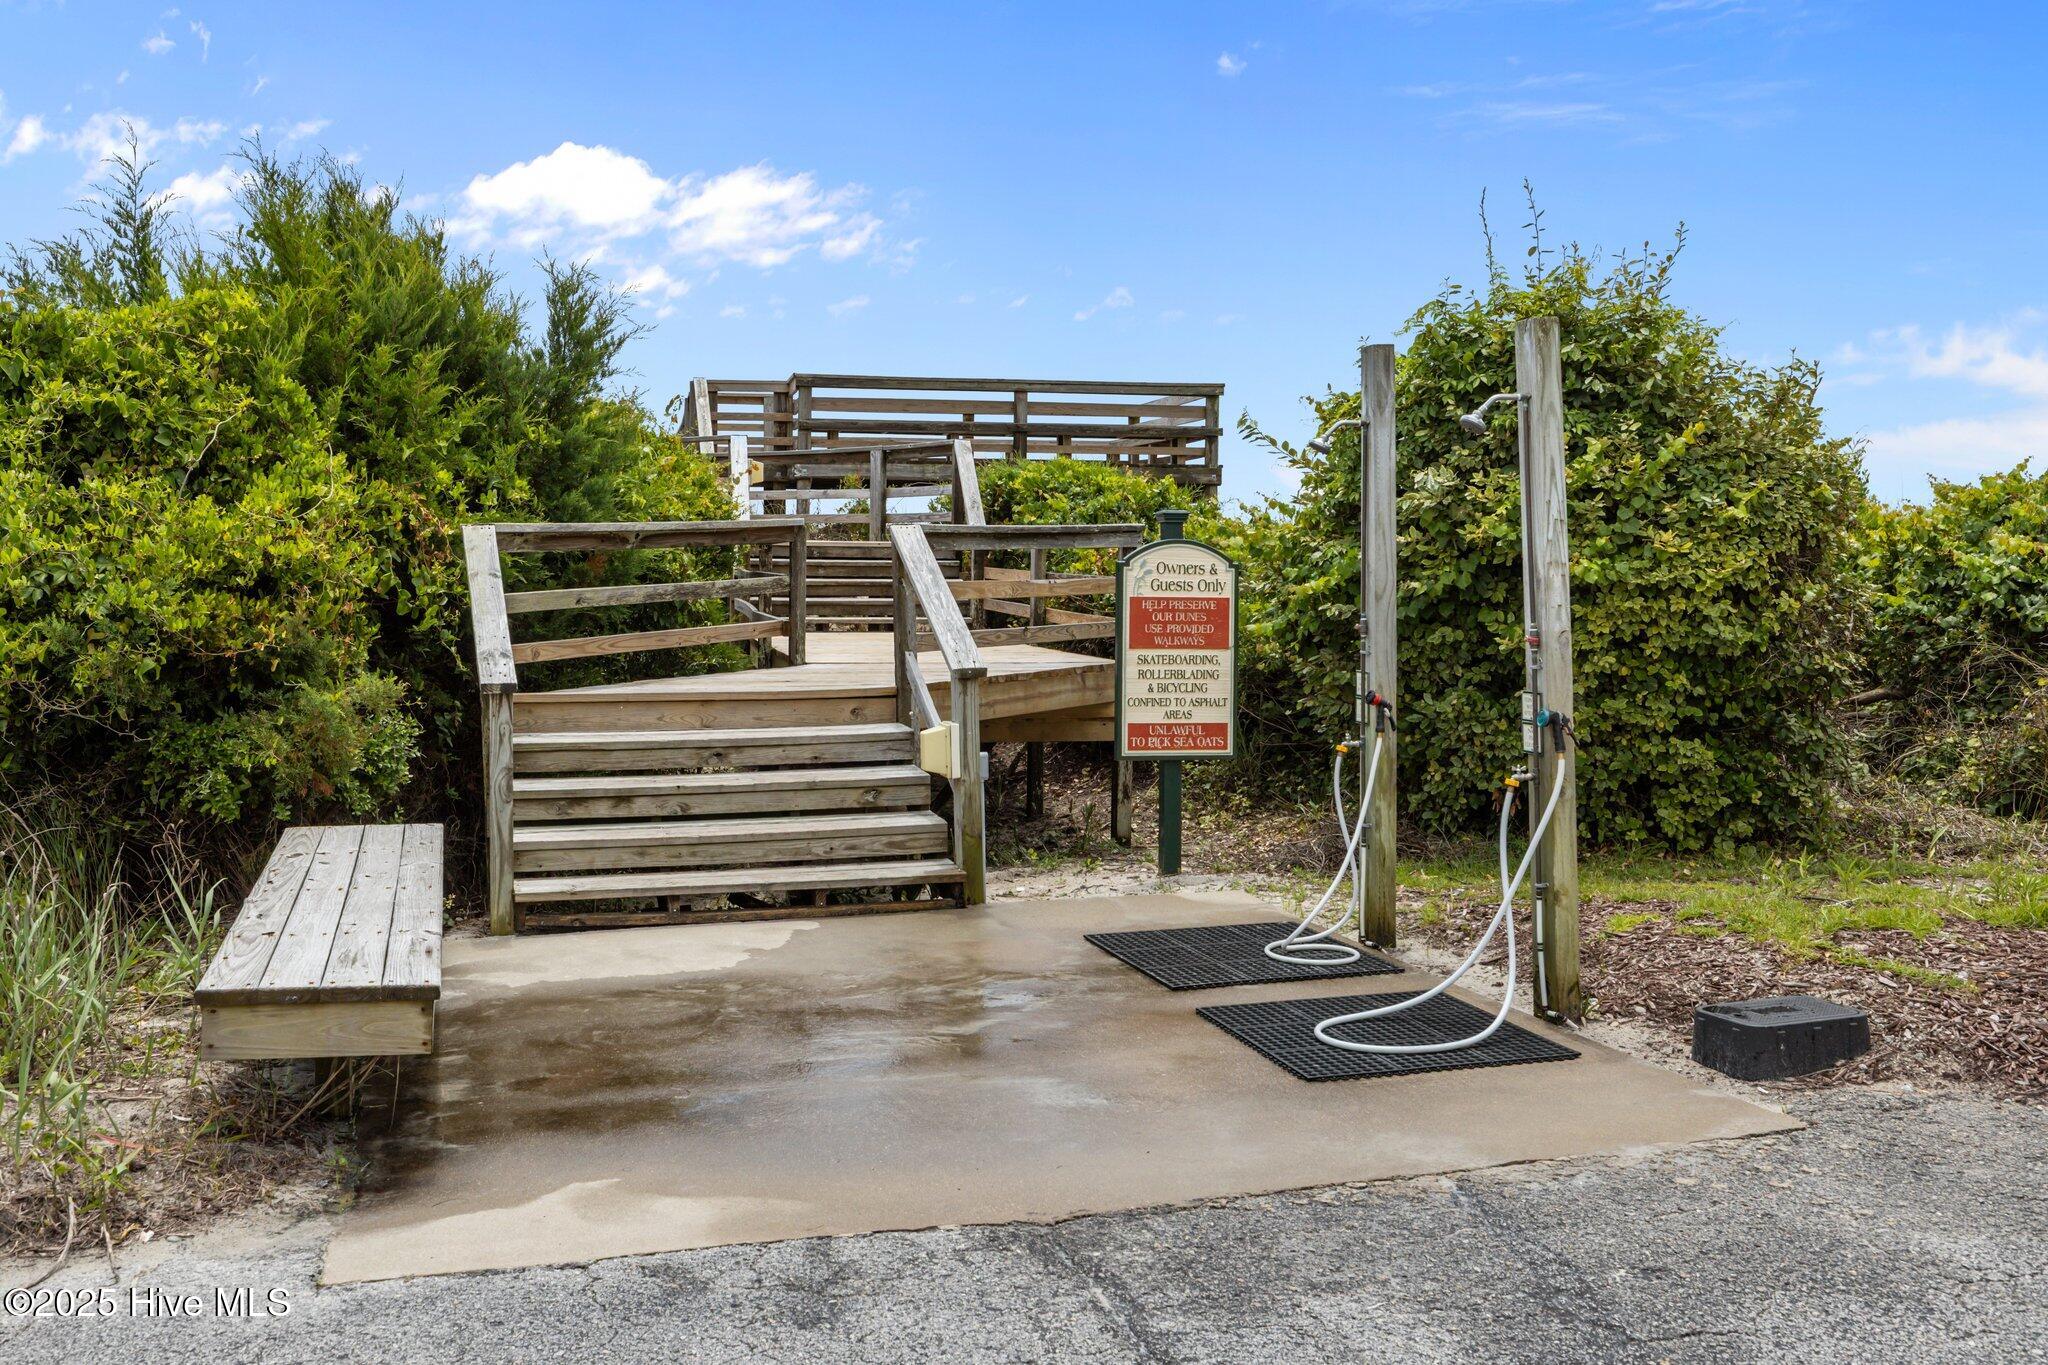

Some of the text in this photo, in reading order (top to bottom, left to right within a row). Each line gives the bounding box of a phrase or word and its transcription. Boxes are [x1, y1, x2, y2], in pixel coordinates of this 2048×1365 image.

[1156, 561, 1218, 575] Owners &
[1150, 578, 1227, 595] Guests Only
[1142, 600, 1217, 610] HELP PRESERVE
[1152, 612, 1207, 622] OUR DUNES
[1144, 624, 1215, 635] USE PROVIDED
[1154, 636, 1205, 646] WALKWAYS
[1137, 654, 1221, 666] SKATEBOARDING,
[1137, 669, 1220, 680] ROLLERBLADING
[1147, 682, 1208, 693] & BICYCLING
[1127, 697, 1228, 708] CONFINED TO ASPHALT
[1163, 710, 1193, 719] AREAS
[1149, 725, 1205, 736] UNLAWFUL
[1130, 737, 1224, 749] TO PICK SEA OATS
